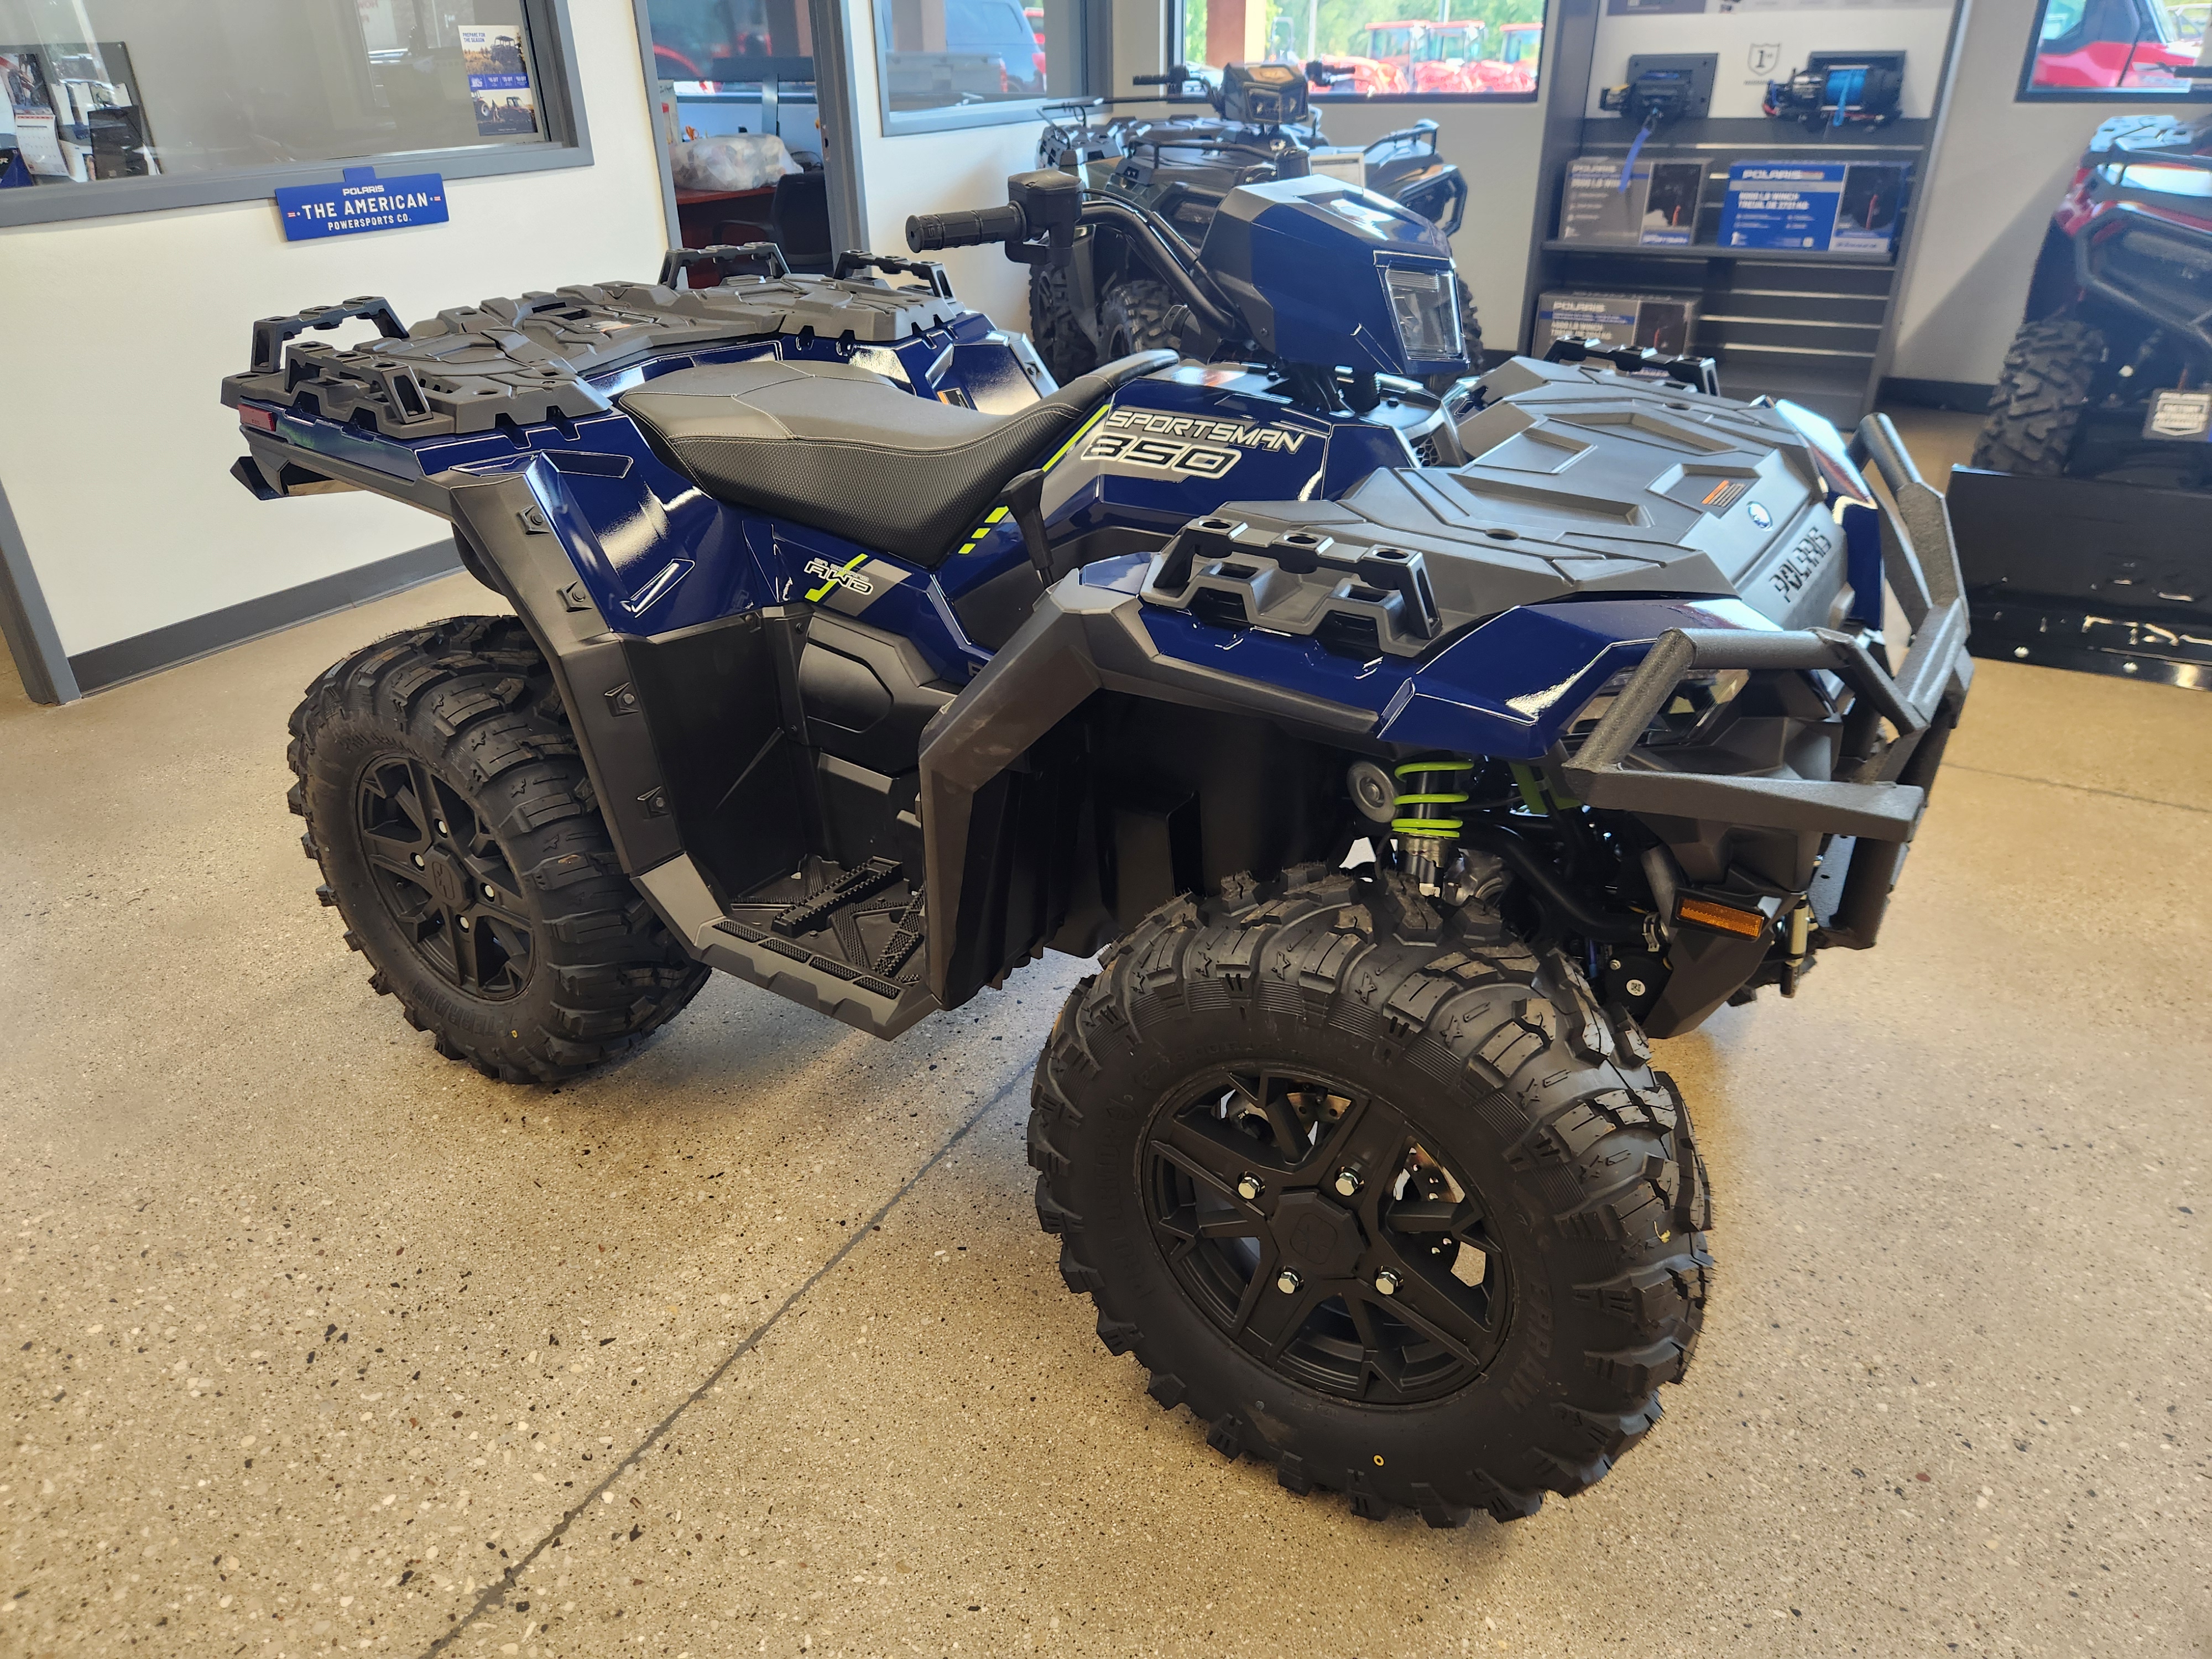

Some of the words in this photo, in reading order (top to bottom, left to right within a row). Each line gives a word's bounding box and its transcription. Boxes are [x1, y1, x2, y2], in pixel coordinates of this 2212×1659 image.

[1742, 169, 1803, 180] POLARIS
[342, 184, 385, 196] POLARIS
[301, 202, 337, 220] THE
[344, 192, 429, 216] AMERICAN
[327, 215, 394, 231] POWERSPORTS
[1105, 410, 1307, 455] SPORTSMAN
[1081, 432, 1242, 479] 850
[804, 560, 874, 596] AWD
[830, 564, 870, 582] DEMAND
[1769, 526, 1832, 603] POLARIS
